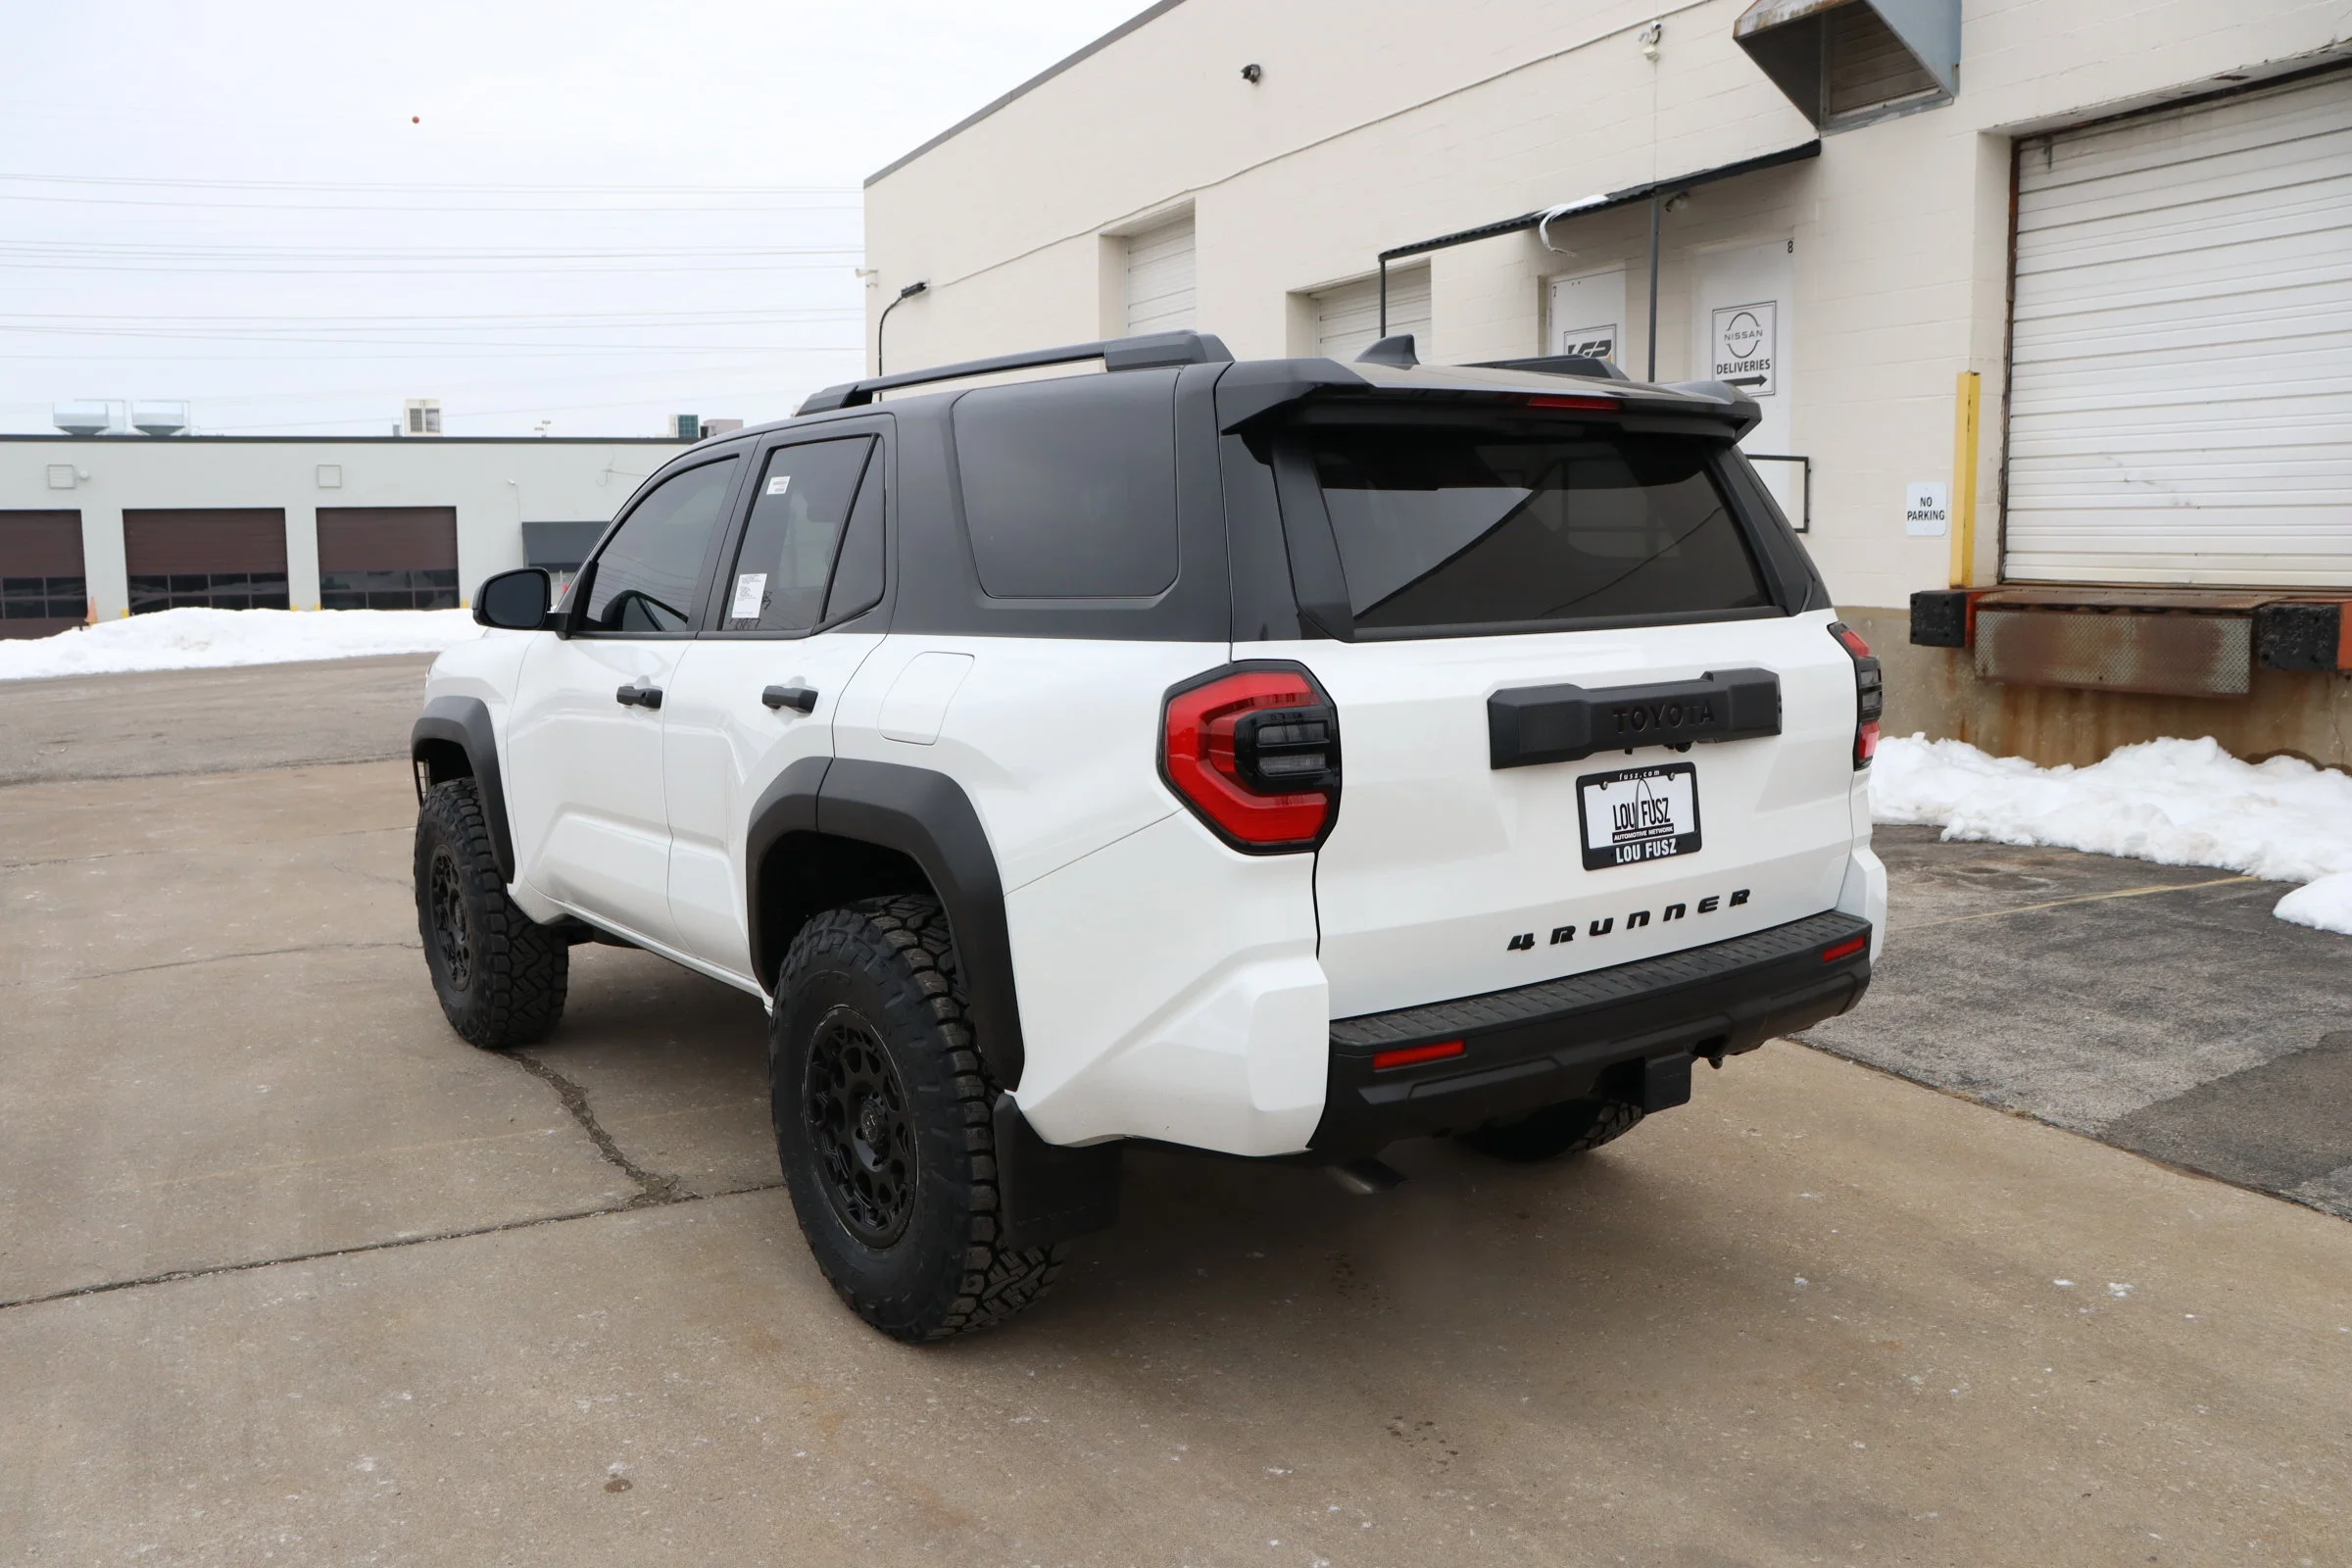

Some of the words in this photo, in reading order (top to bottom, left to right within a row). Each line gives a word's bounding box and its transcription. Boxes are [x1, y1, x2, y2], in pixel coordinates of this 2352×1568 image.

[1788, 240, 1794, 254] 8
[1552, 285, 1558, 298] 7
[1724, 328, 1764, 342] NISSAN
[1716, 359, 1771, 375] DELIVERIES
[1920, 496, 1933, 508] NO
[1906, 510, 1945, 521] PARKING
[1612, 701, 1716, 734] TOYOTA
[1619, 769, 1660, 781] fusz.com
[1612, 802, 1636, 831] LOU
[1641, 797, 1671, 826] FUSZ
[1613, 830, 1647, 842] AUTOMOTIVE
[1648, 826, 1674, 836] NETWORK
[1615, 844, 1641, 863] LOU
[1645, 838, 1677, 858] FUSZ
[1506, 888, 1750, 952] 4RUNNER
